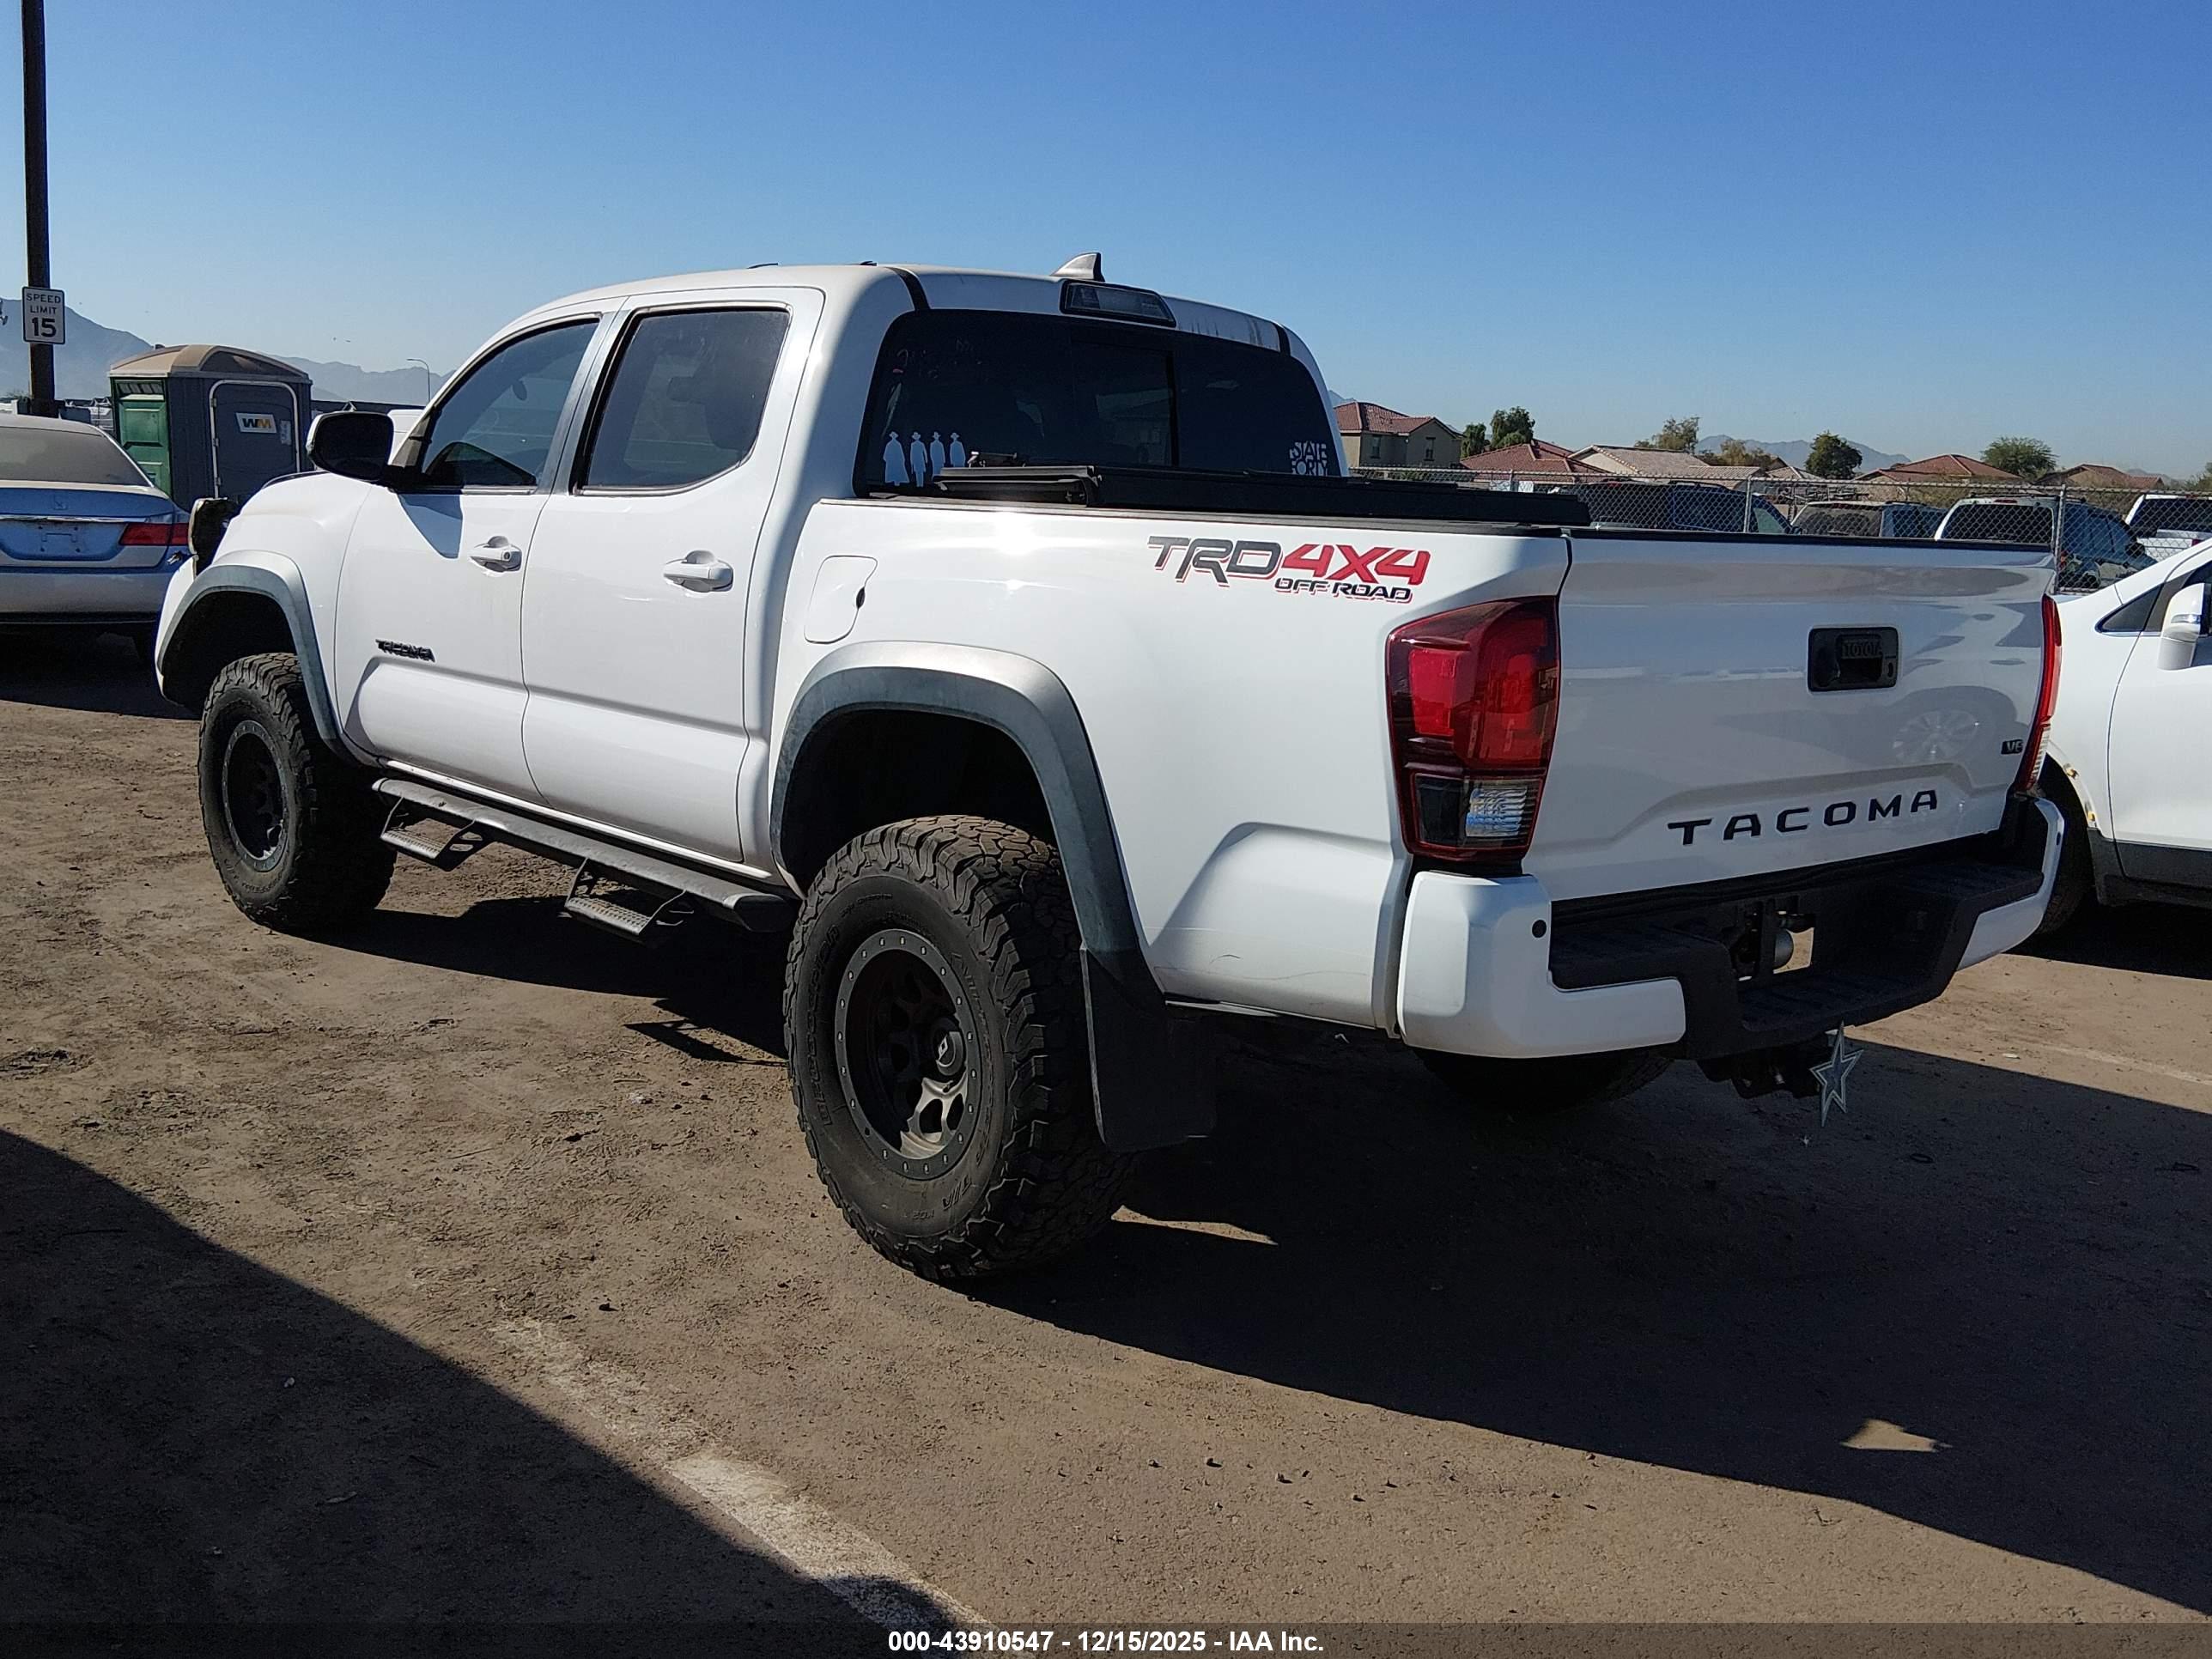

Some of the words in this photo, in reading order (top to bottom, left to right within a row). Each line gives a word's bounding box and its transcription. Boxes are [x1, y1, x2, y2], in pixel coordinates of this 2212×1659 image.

[27, 293, 61, 303] SPEED
[30, 305, 57, 314] LIMIT
[32, 317, 57, 337] 15
[241, 418, 271, 428] WM
[1290, 441, 1328, 460] STATE
[1147, 535, 1282, 587] TRD
[1273, 577, 1330, 596] OFF
[1331, 581, 1413, 604] ROAD
[1667, 789, 1938, 846] TACOMA
